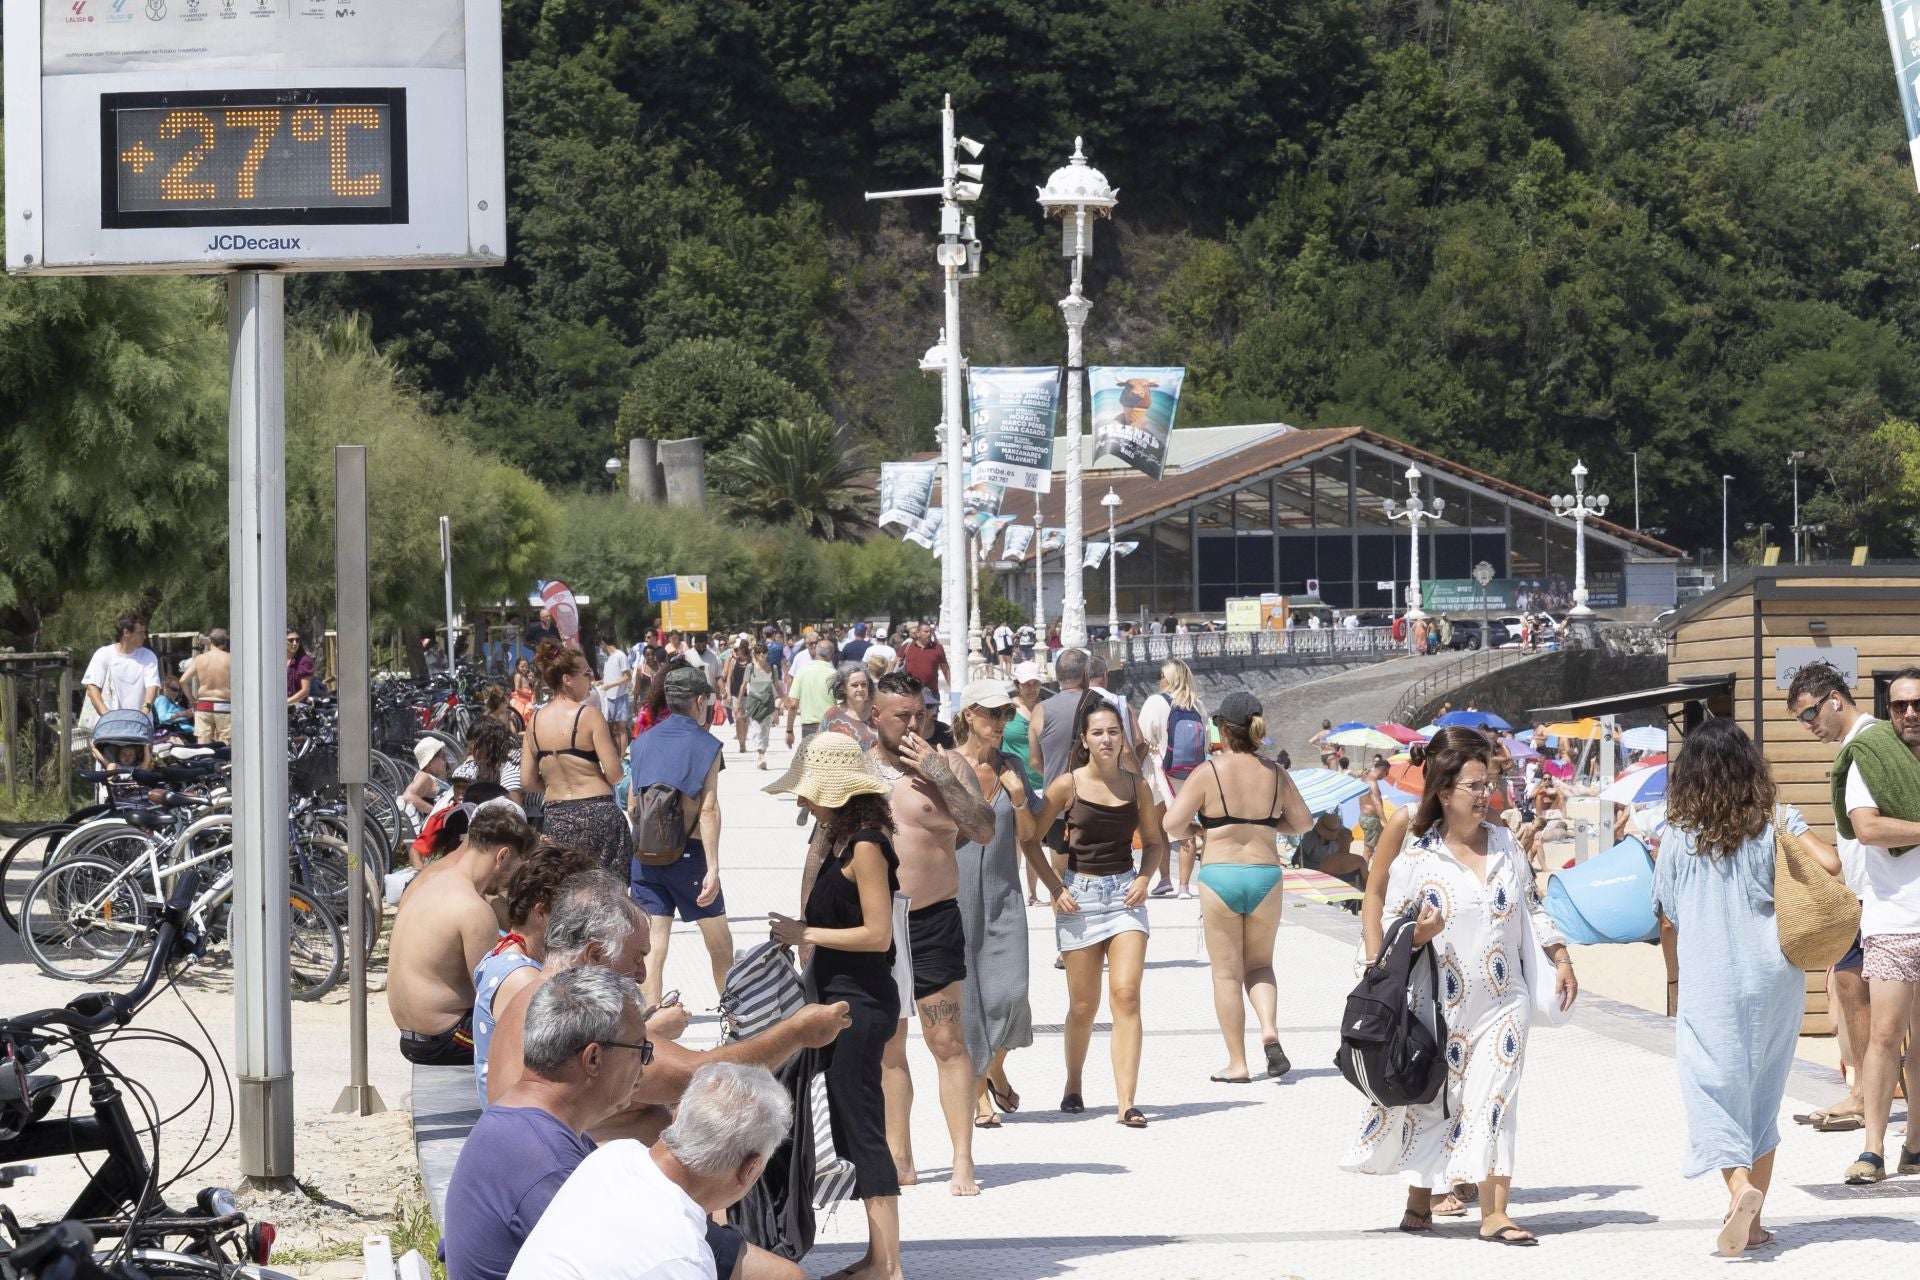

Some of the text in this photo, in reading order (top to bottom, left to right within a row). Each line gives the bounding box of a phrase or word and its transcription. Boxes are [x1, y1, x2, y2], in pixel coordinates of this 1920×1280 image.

[208, 234, 301, 251] JCDecaux
[1022, 400, 1050, 408] AGUADO
[974, 410, 989, 426] 15
[1009, 414, 1040, 423] MORANTE
[1020, 426, 1047, 437] CASADO
[974, 438, 989, 455] 16
[1001, 448, 1042, 459] MANZANARES
[1005, 453, 1038, 464] TALAVANTE
